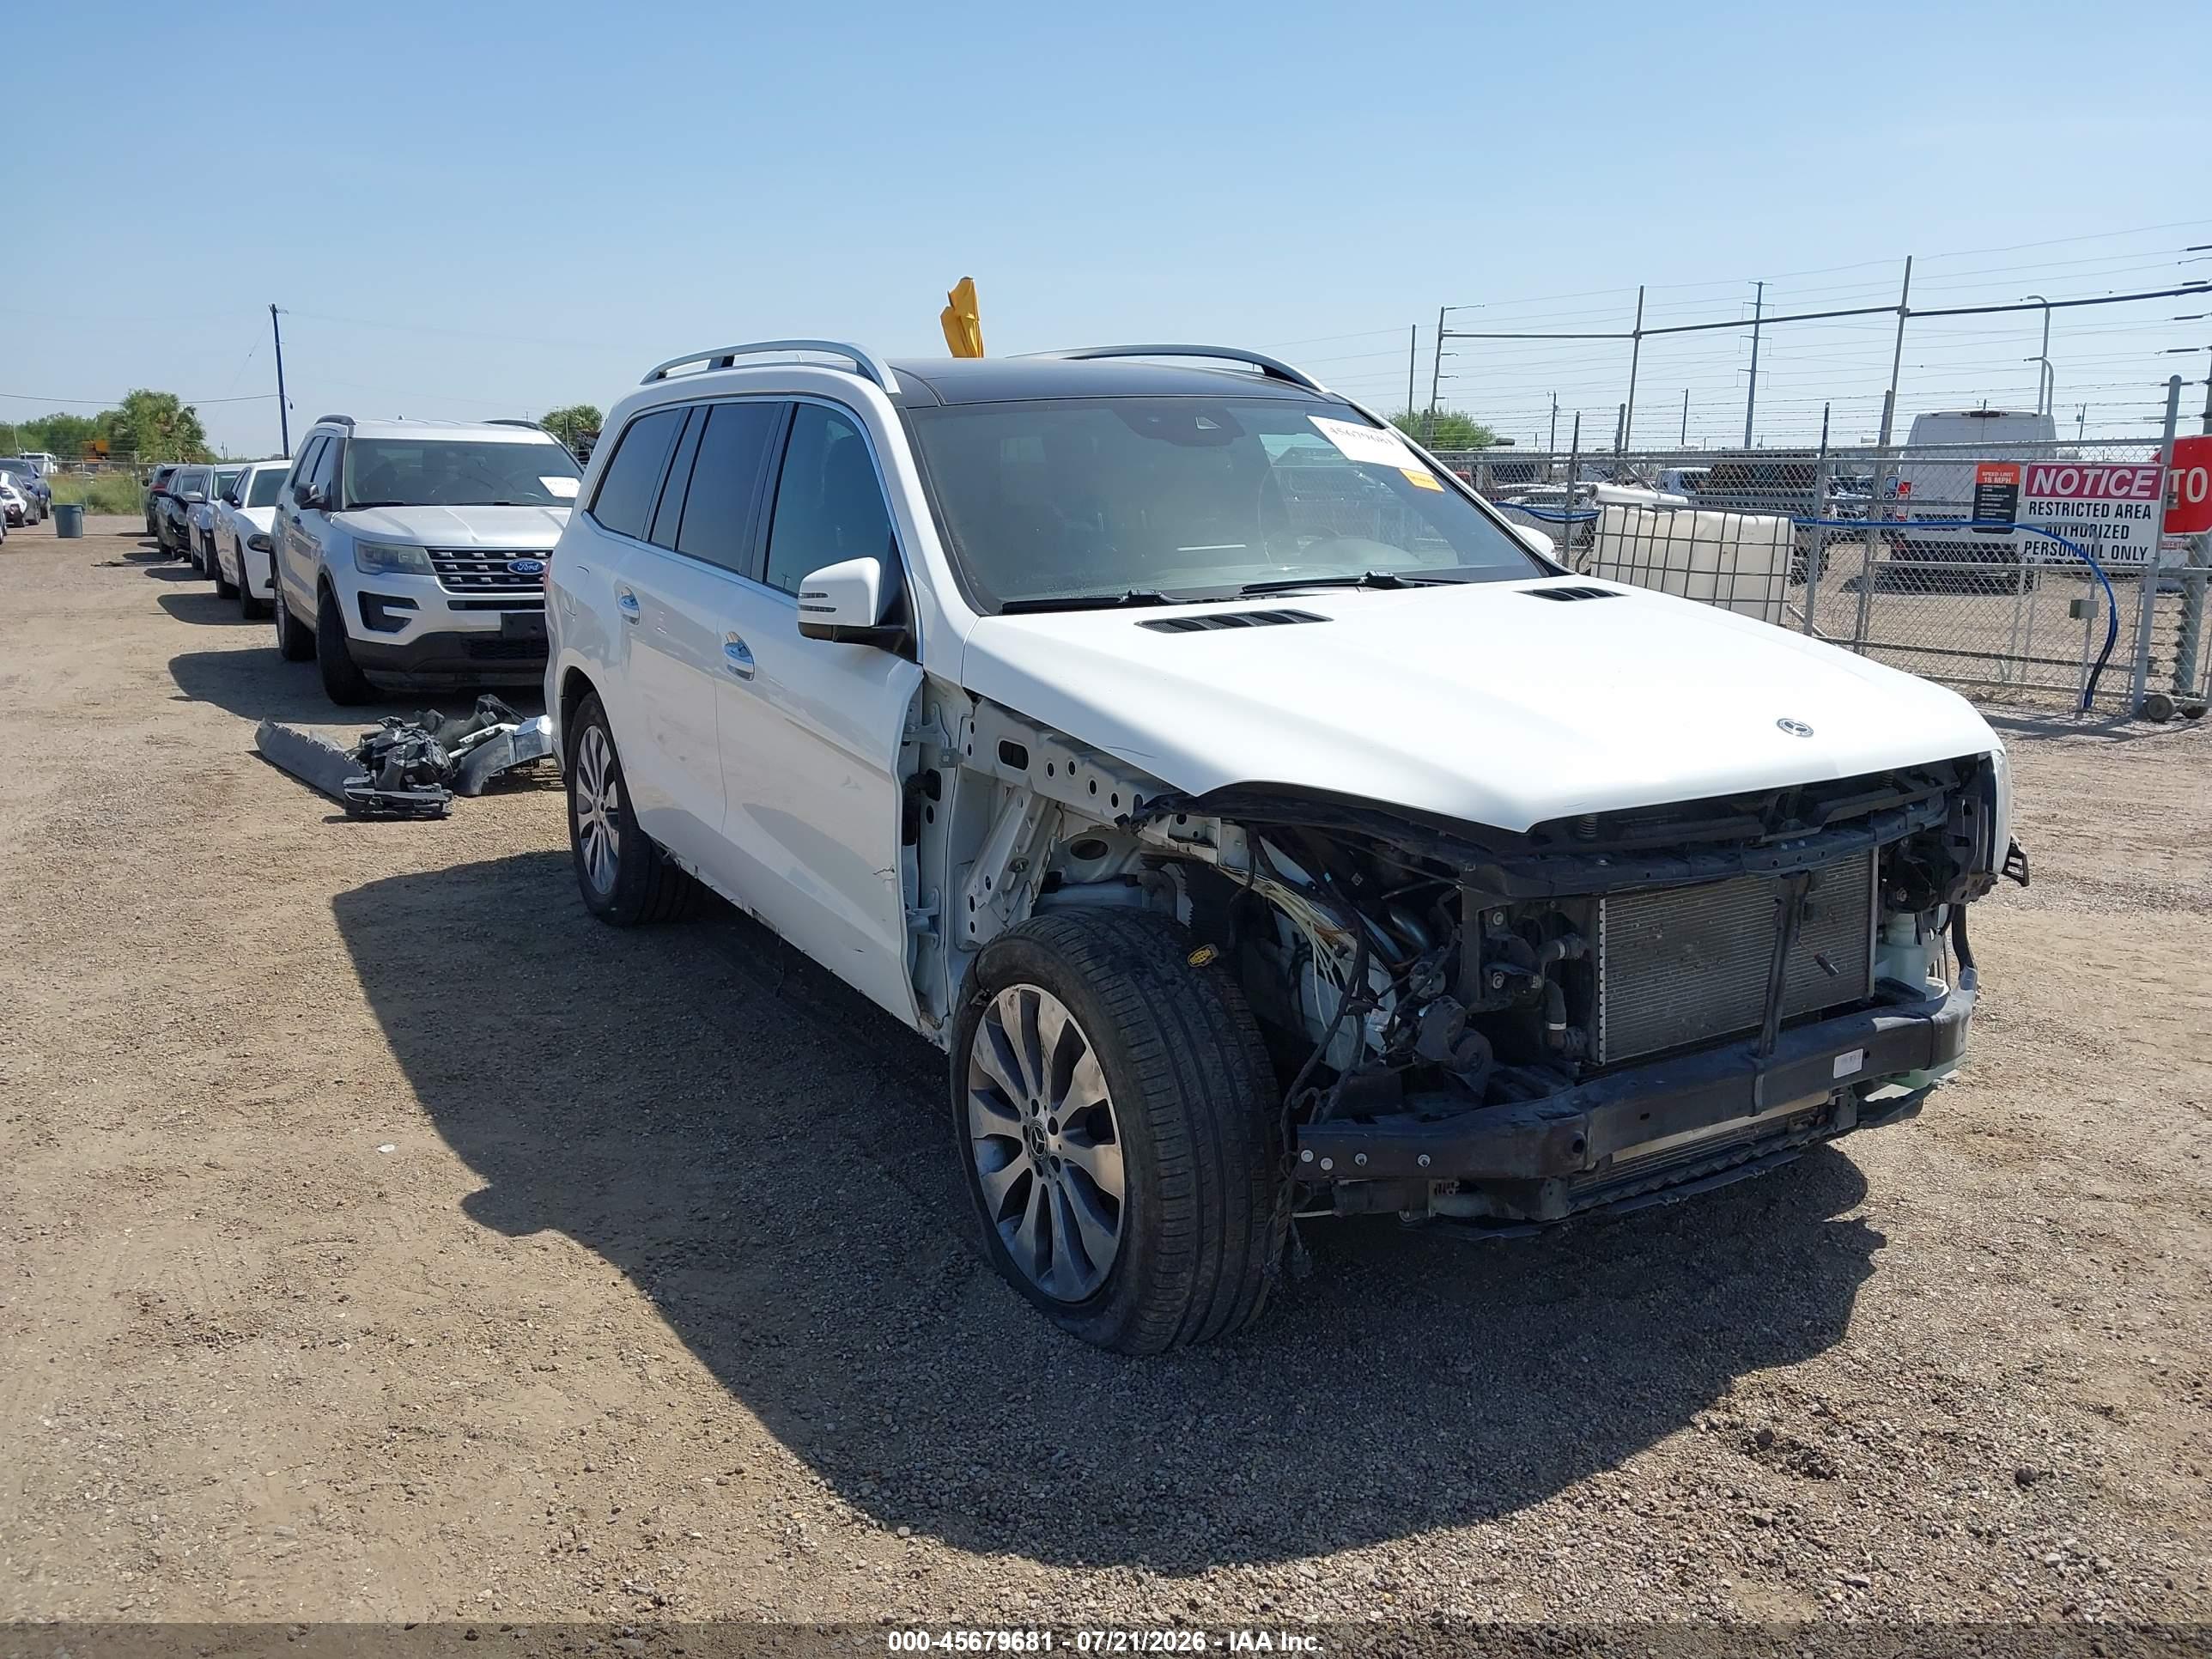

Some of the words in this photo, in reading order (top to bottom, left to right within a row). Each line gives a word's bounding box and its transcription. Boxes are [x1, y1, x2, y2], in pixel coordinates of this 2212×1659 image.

[2031, 468, 2157, 498] NOTICE
[2169, 466, 2212, 504] TO
[2028, 501, 2111, 518] RESTRICTED
[2114, 503, 2152, 520] AREA
[2045, 521, 2130, 540] AUTHORIZED
[2111, 544, 2149, 562] ONLY
[517, 561, 540, 572] Ford
